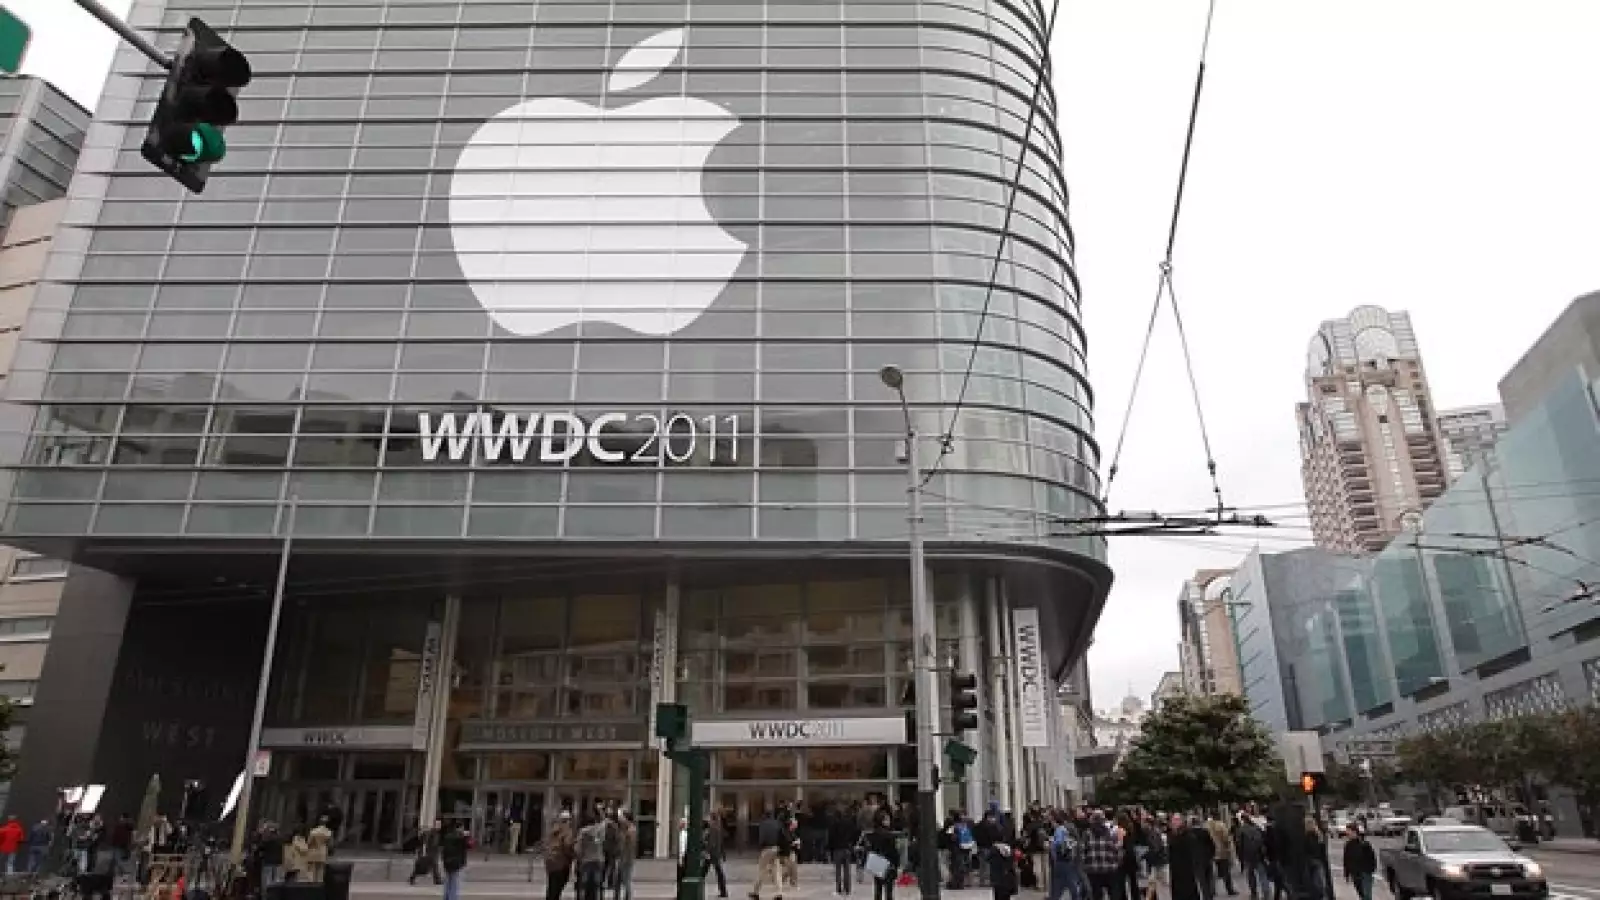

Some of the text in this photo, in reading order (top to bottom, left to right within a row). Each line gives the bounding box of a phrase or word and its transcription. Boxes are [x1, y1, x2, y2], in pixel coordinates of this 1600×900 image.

[418, 412, 740, 463] WWDC2011
[1018, 622, 1042, 731] WWDC2011
[749, 720, 844, 740] WWDC2011
